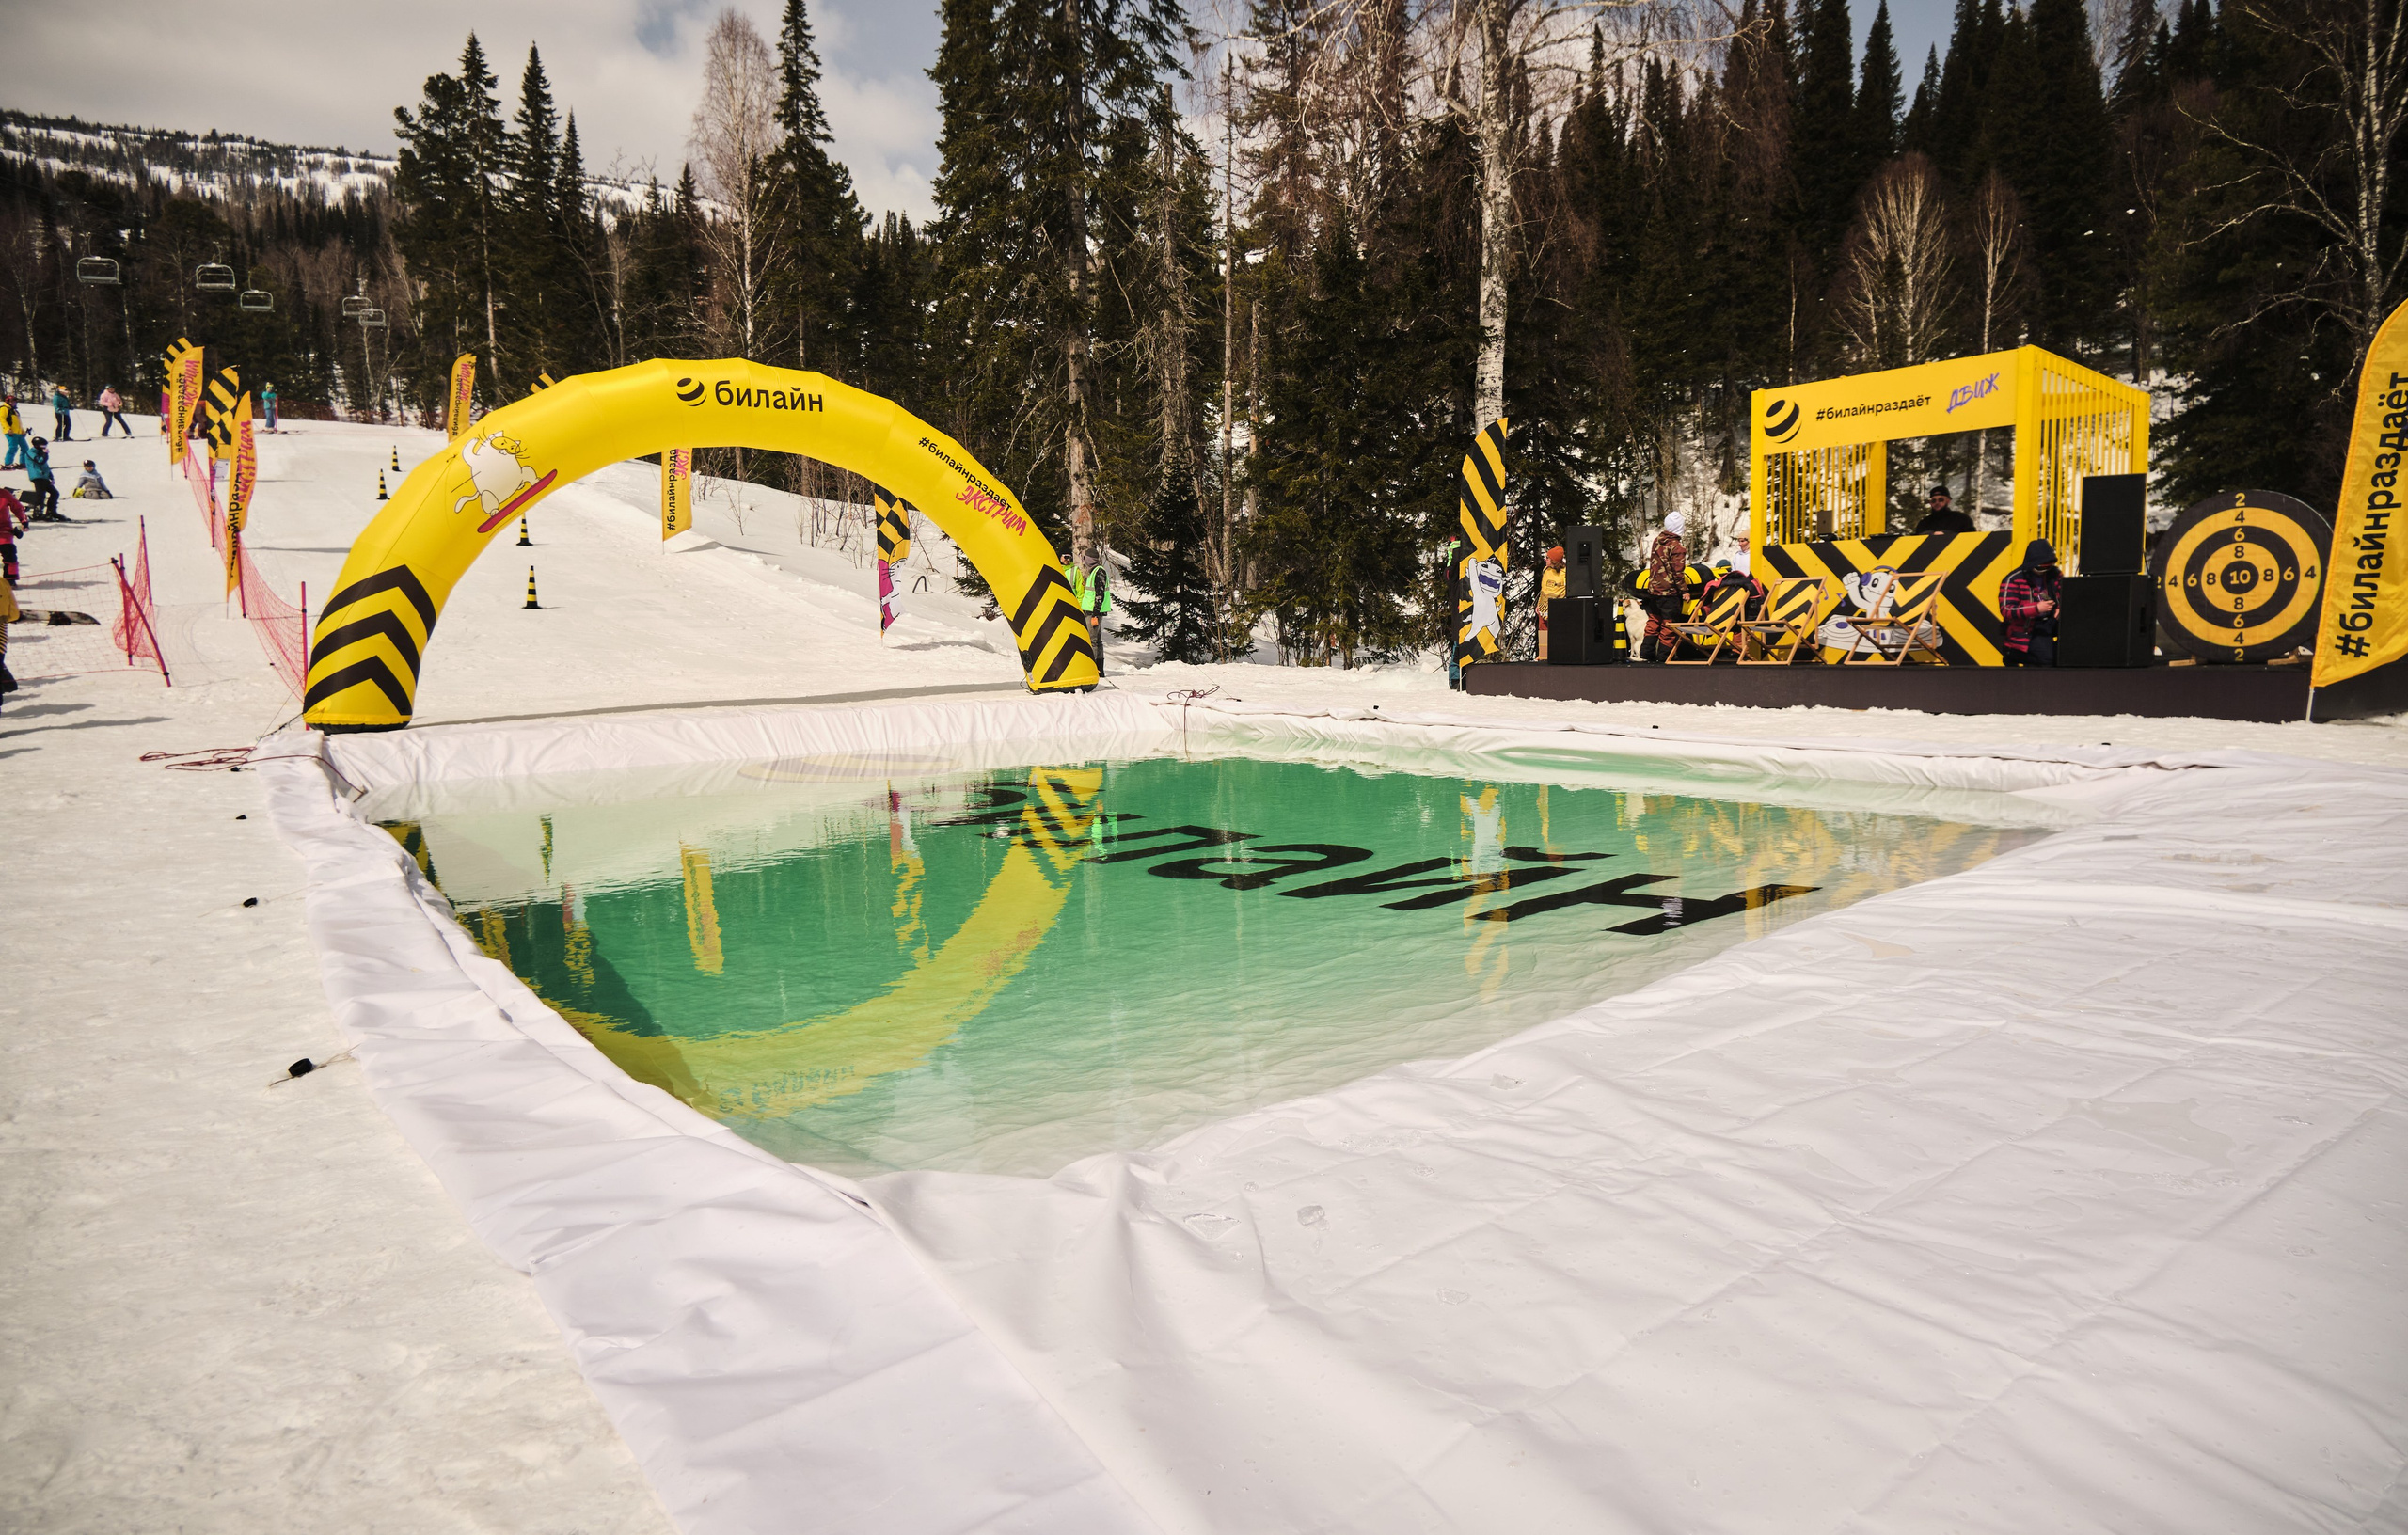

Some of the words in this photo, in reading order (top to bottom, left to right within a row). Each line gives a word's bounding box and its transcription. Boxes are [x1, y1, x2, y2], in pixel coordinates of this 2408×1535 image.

[715, 380, 823, 412] билайн
[1946, 372, 2000, 414] ДВИЖ
[1815, 394, 1931, 421] #билайнраздаёт
[673, 448, 689, 481] ЭКСТ
[918, 436, 1012, 511] #билайнраздаёт
[666, 448, 678, 530] #билайнразда
[2235, 493, 2246, 507] 2
[955, 485, 1027, 537] ЭКСТРИМ
[2234, 510, 2245, 523] 4
[2334, 372, 2408, 658] #билайнраздаёт
[2234, 528, 2245, 542] 6
[2234, 546, 2244, 559] 8
[2168, 575, 2178, 587] 4
[2187, 573, 2197, 587] 6
[2206, 572, 2216, 585] 8
[2229, 569, 2251, 585] 10
[2263, 568, 2273, 582] 8
[2283, 566, 2295, 581] 6
[2305, 565, 2317, 579] 4
[2233, 597, 2244, 610] 8
[2233, 614, 2244, 628] 6
[2233, 632, 2244, 644] 4
[2233, 648, 2244, 661] 2
